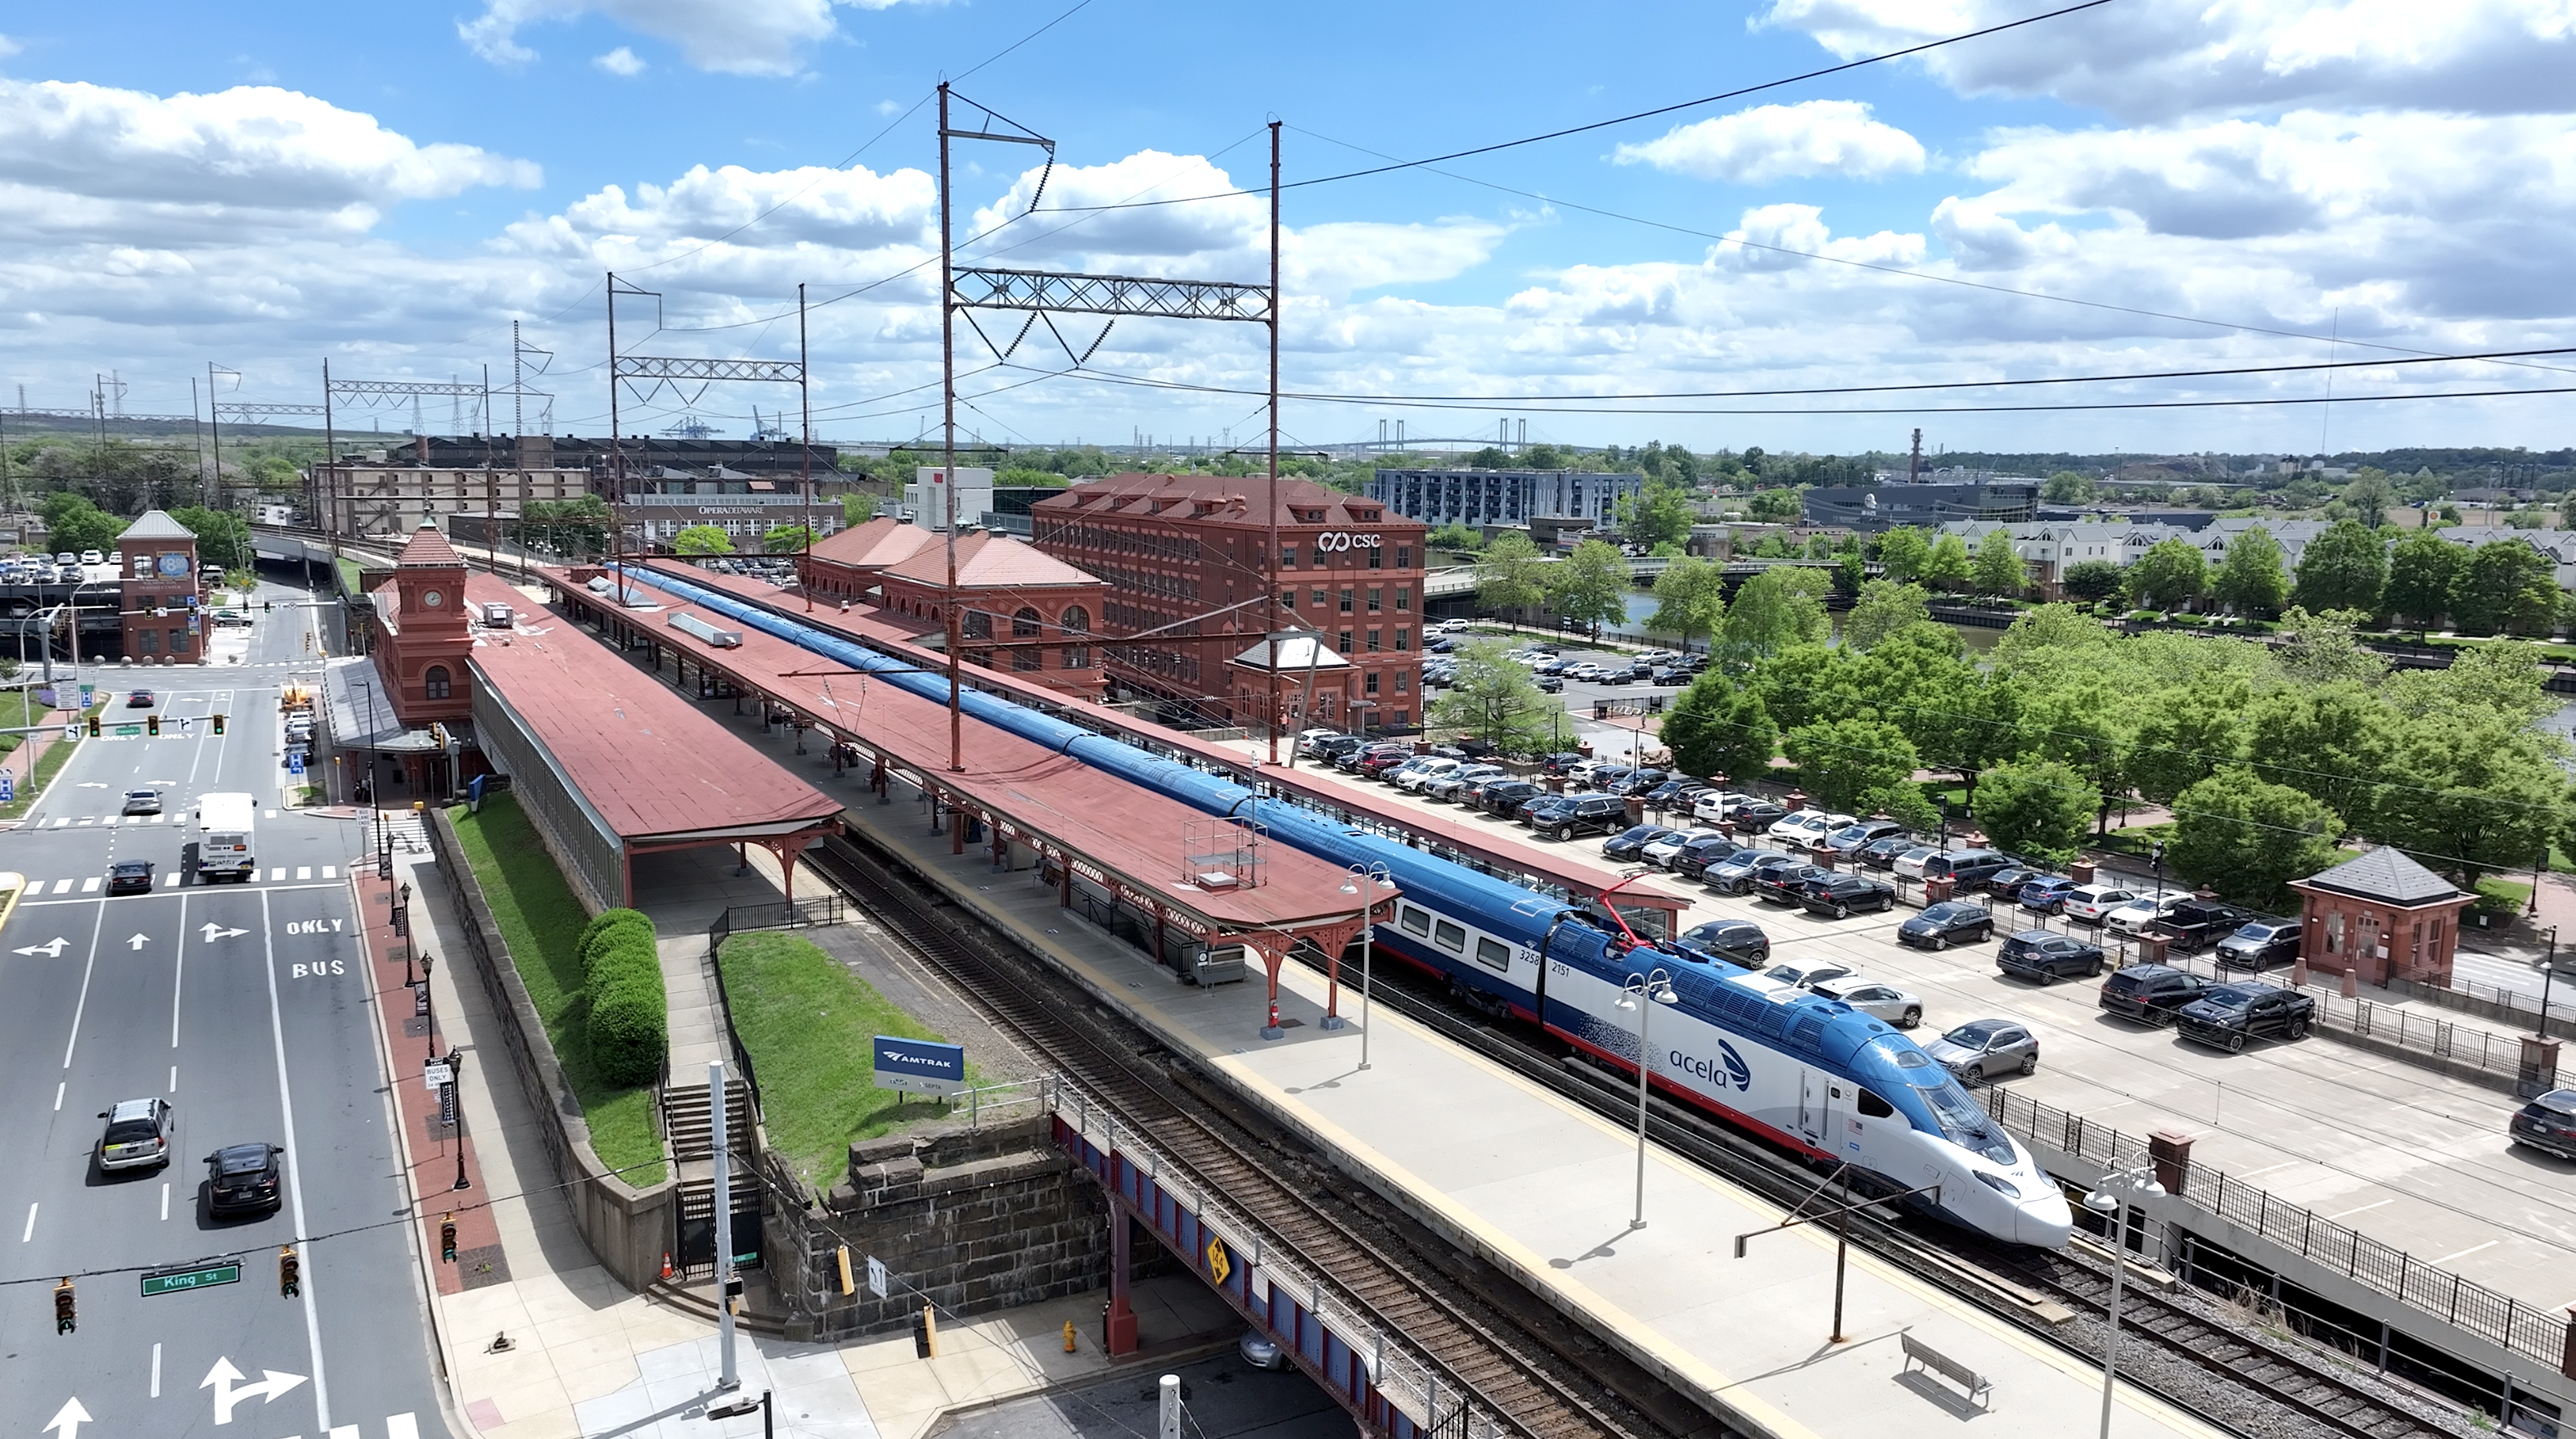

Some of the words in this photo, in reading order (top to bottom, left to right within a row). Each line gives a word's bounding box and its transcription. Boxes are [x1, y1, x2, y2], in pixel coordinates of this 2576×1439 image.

[1352, 534, 1380, 548] CSC
[290, 754, 301, 765] H
[287, 918, 343, 935] ONLY
[1520, 949, 1541, 966] 3258
[292, 959, 345, 979] BUS
[1551, 962, 1570, 977] 2151
[901, 1056, 951, 1068] AMTRAK
[1670, 1050, 1727, 1089] acela
[426, 1067, 448, 1075] BUSES
[164, 1276, 196, 1288] King
[205, 1273, 218, 1282] St
